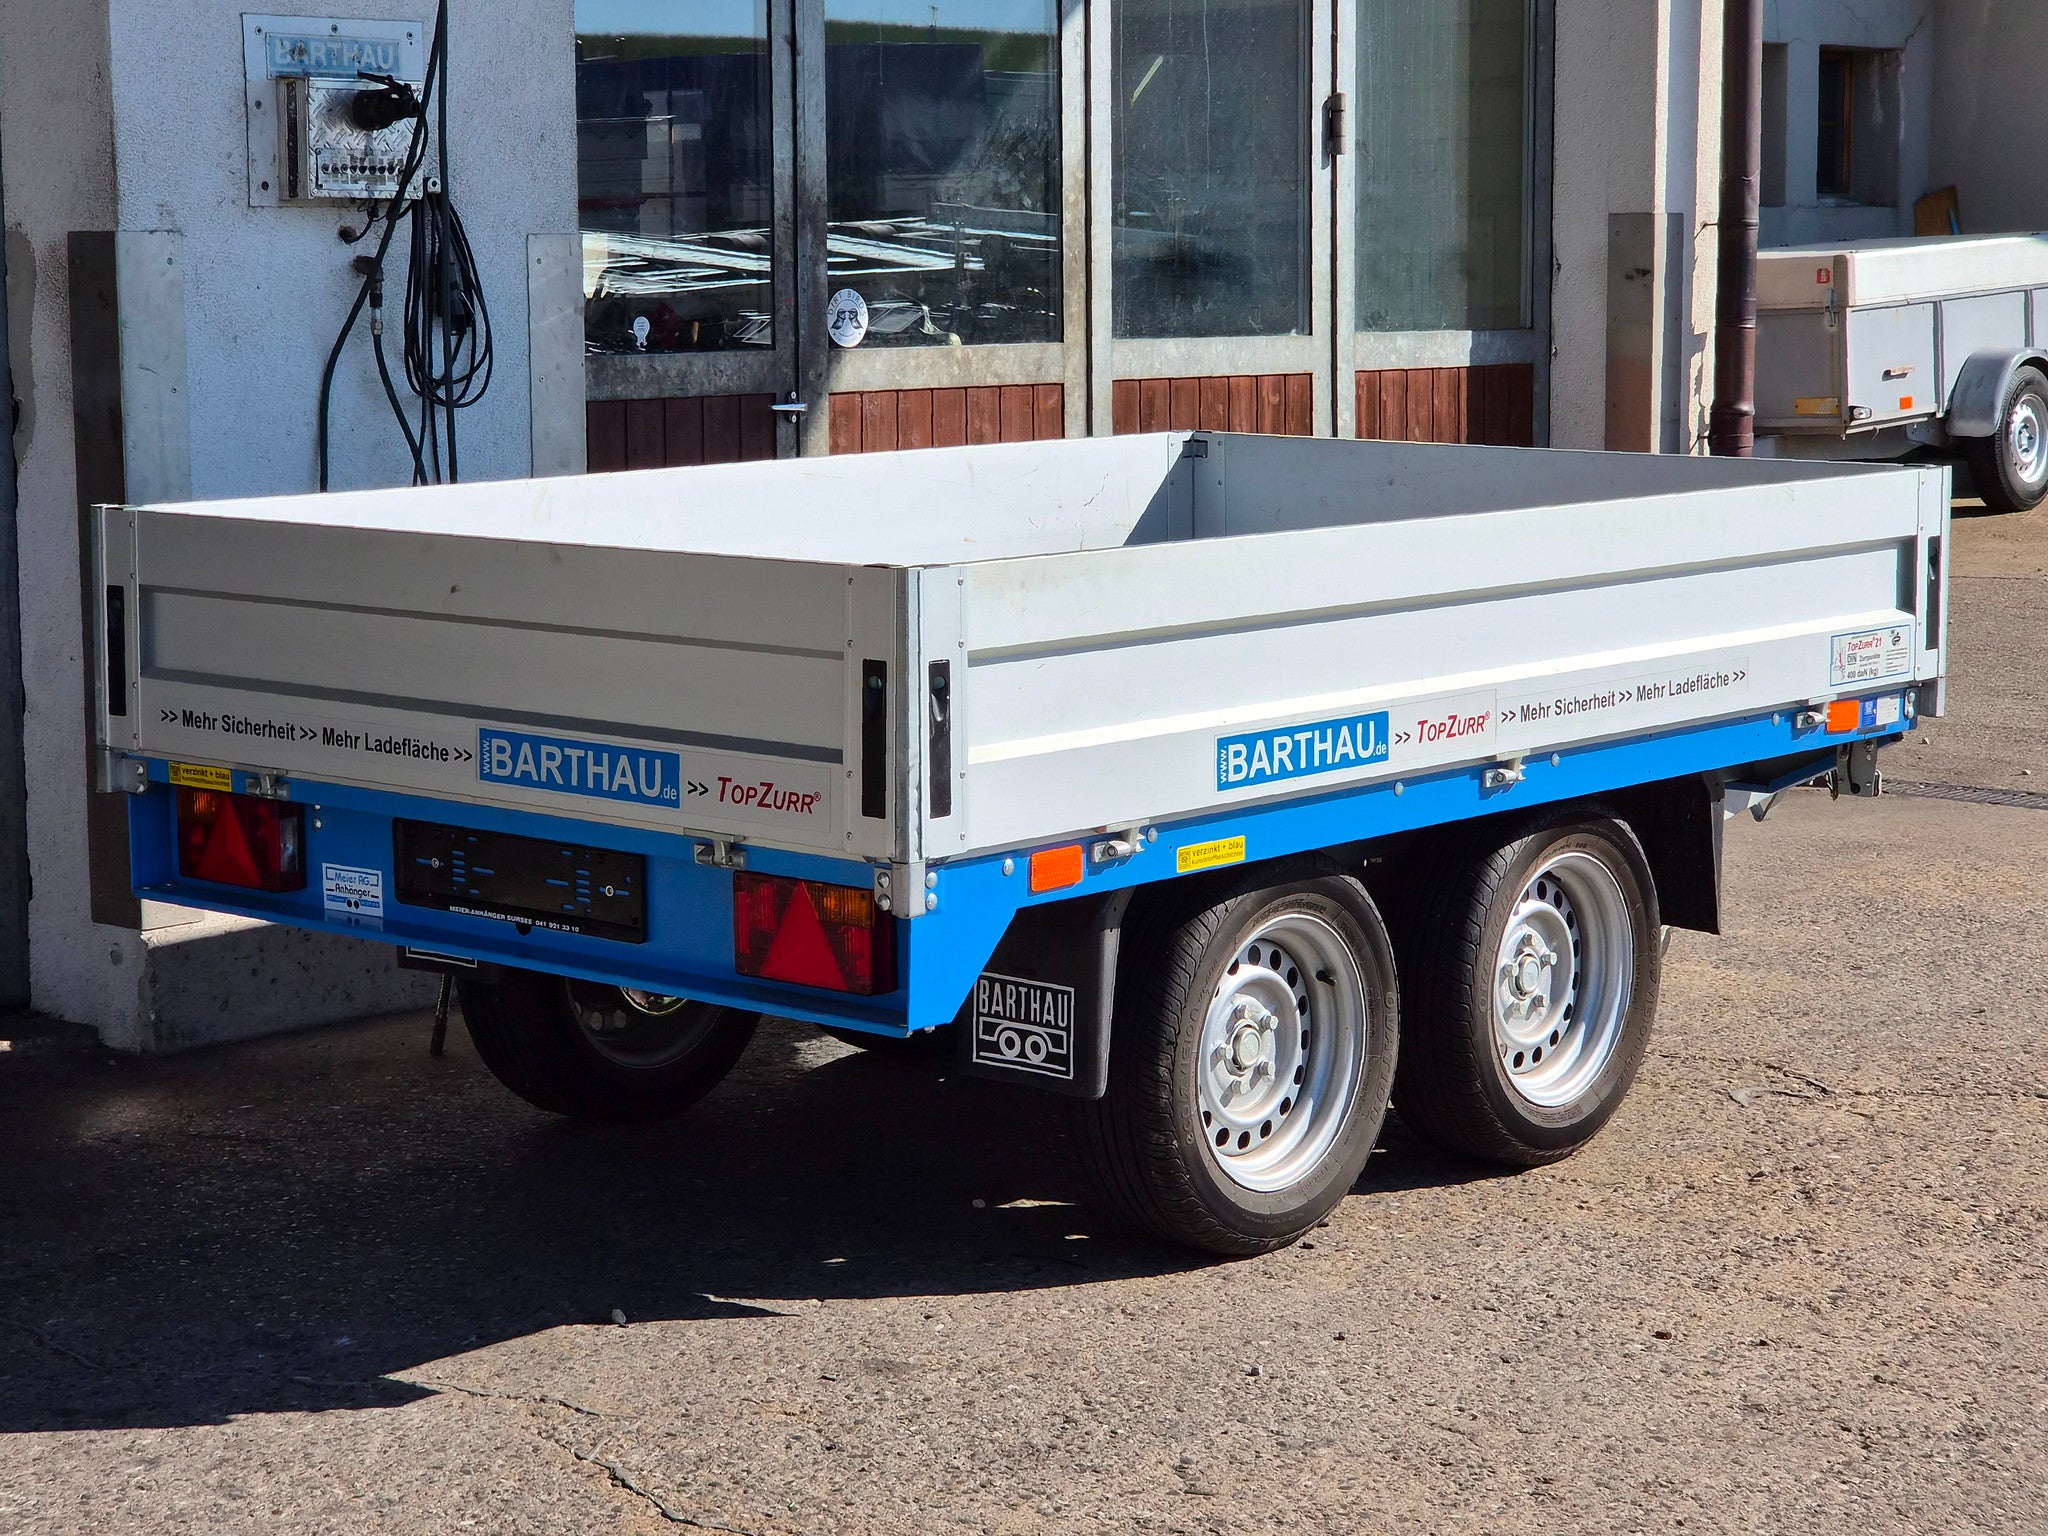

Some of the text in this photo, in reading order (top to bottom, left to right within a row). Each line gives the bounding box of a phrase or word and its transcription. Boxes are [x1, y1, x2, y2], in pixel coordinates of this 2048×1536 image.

[276, 40, 394, 70] BARTHAU
[1520, 703, 1551, 723] Mehr
[1554, 690, 1616, 716] Sicherheit
[1636, 684, 1666, 702] Mehr
[1668, 671, 1730, 697] Ladefläche
[182, 709, 218, 730] Mehr
[221, 714, 296, 741] Sicherheit
[322, 727, 361, 750] Mehr
[364, 732, 449, 762] Ladefläche
[182, 767, 208, 777] verzinkt
[215, 770, 230, 780] blau
[1192, 845, 1220, 857] verzinkt
[1228, 840, 1244, 850] blau
[334, 871, 370, 886] Meier AG
[535, 920, 547, 928] 041
[548, 922, 560, 930] 921
[979, 979, 1068, 1027] BARTHAU
